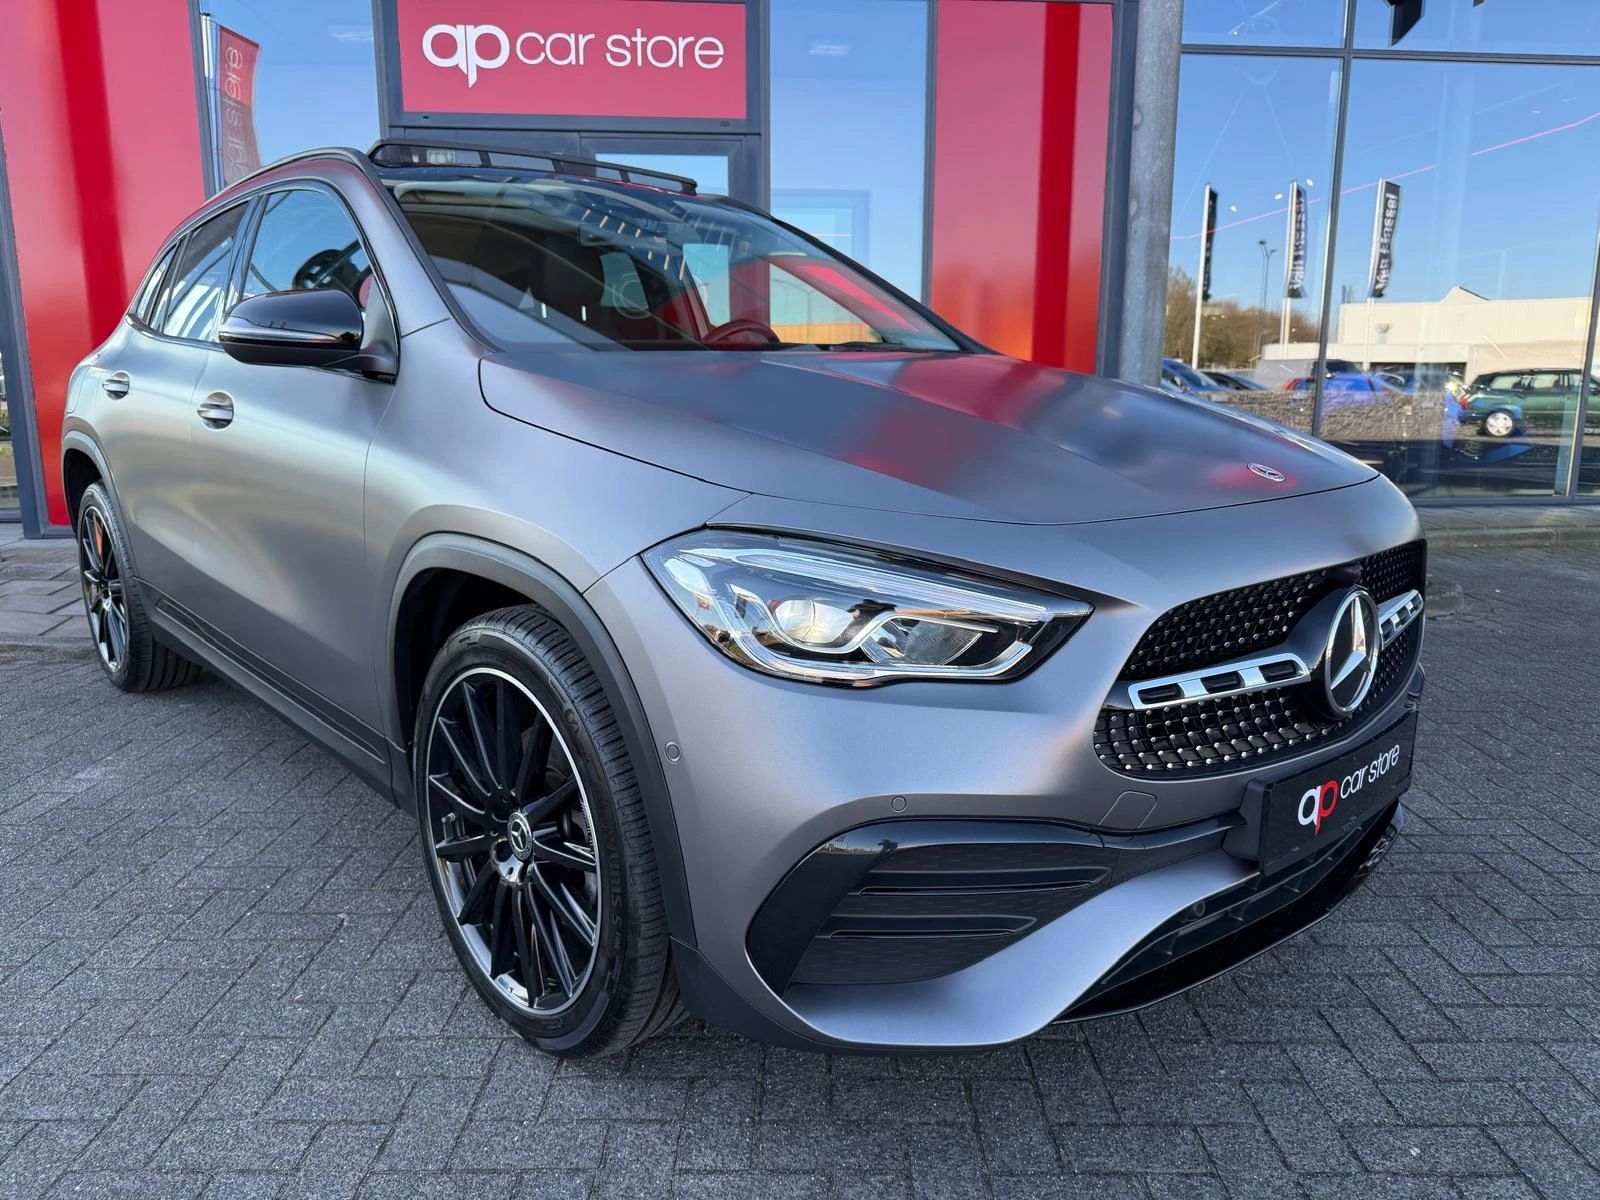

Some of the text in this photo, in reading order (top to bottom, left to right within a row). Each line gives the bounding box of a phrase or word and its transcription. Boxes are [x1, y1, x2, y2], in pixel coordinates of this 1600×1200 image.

[516, 32, 595, 66] car
[605, 28, 725, 69] store
[222, 46, 243, 128] store
[1340, 765, 1369, 799] car
[1368, 744, 1400, 783] store
[610, 912, 622, 927] 5
